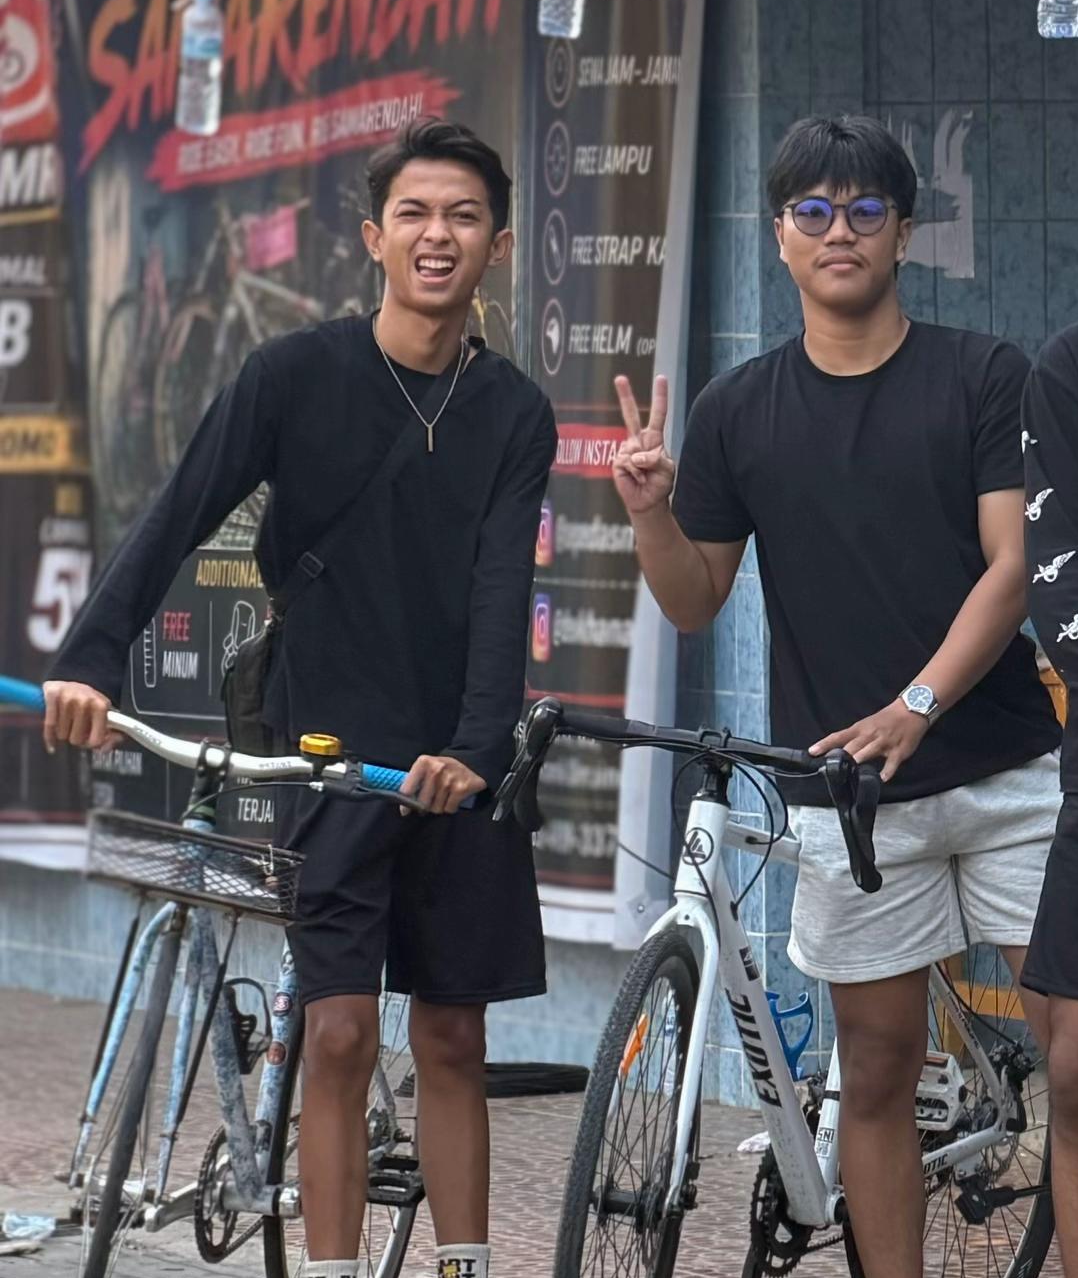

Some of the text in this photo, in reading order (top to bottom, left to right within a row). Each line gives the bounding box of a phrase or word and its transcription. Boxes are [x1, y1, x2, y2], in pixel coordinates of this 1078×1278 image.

[574, 145, 653, 176] FREE LAMPU
[571, 235, 594, 266] FREE
[594, 235, 644, 266] STRAP
[568, 324, 592, 355] FREE
[591, 324, 633, 355] HELM
[162, 610, 192, 642] FREE
[162, 651, 199, 680] MINUM
[725, 987, 782, 1109] EXOTIC
